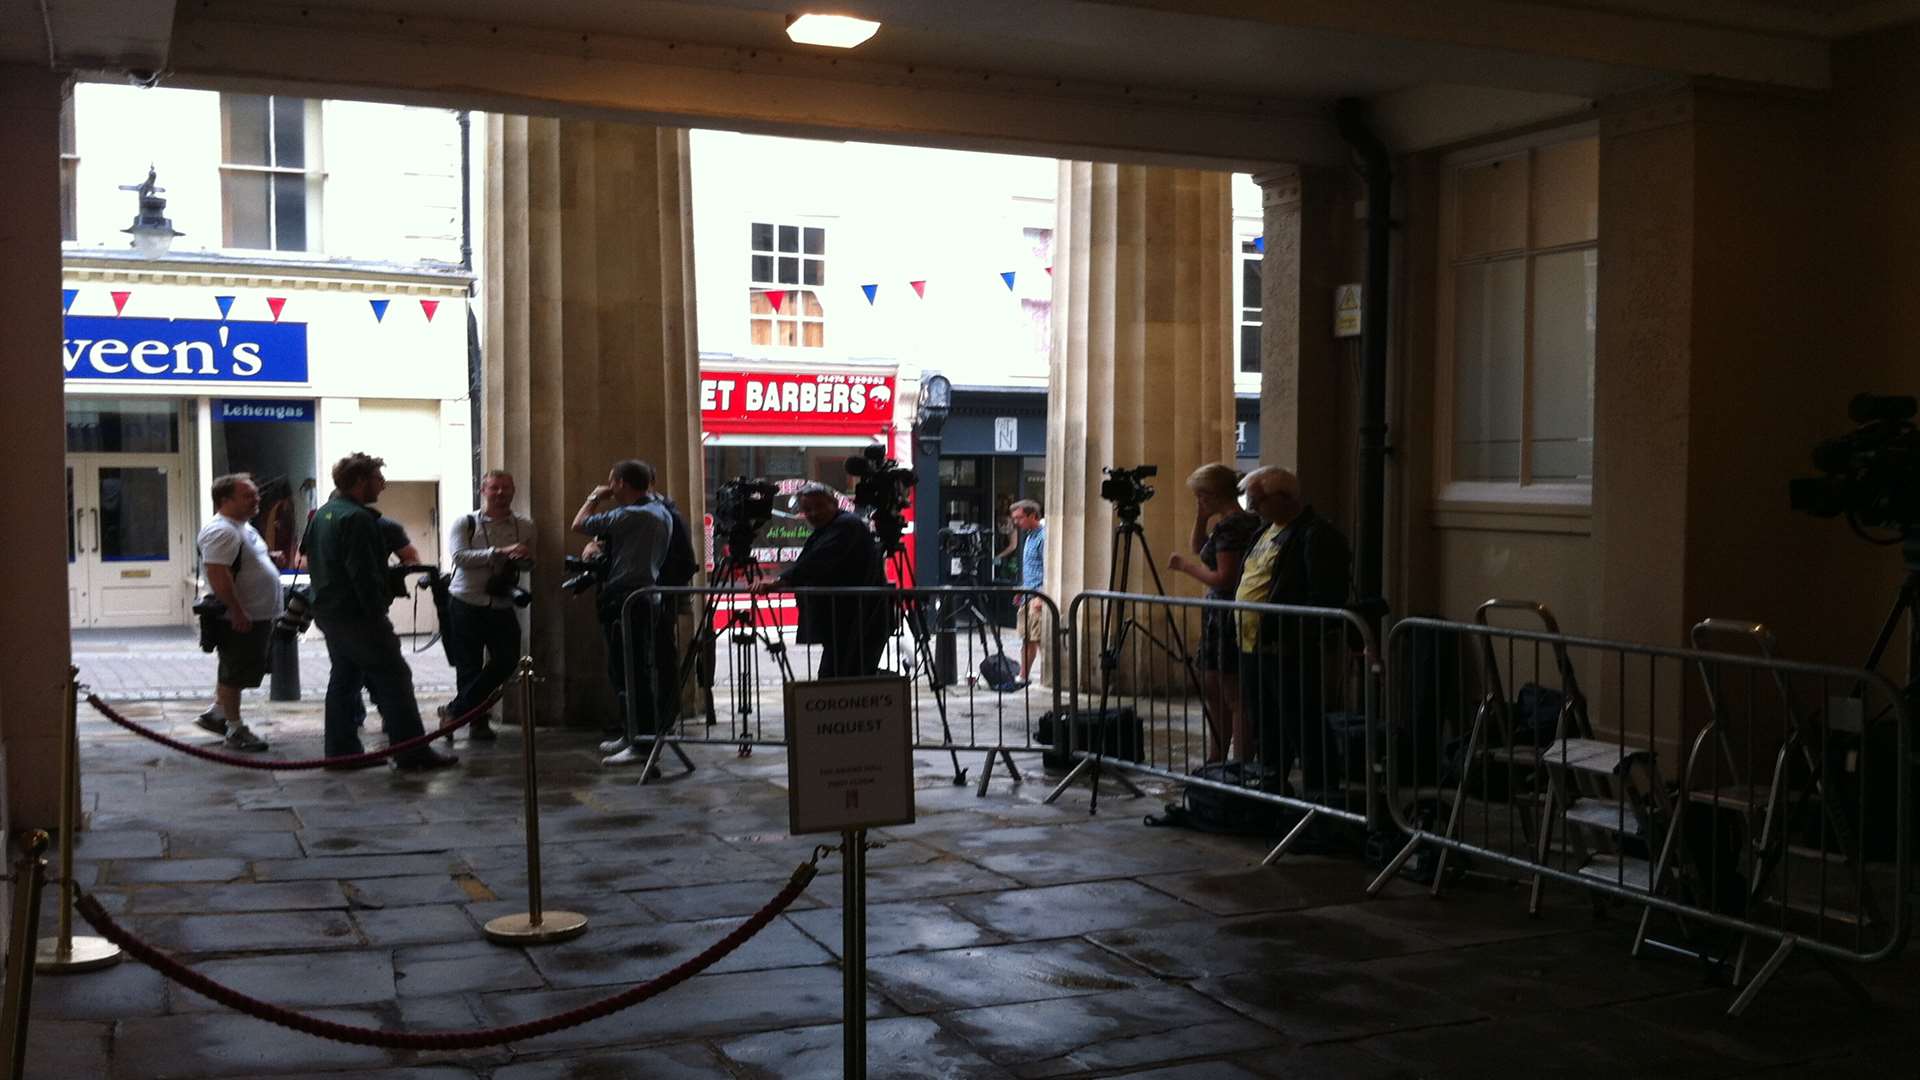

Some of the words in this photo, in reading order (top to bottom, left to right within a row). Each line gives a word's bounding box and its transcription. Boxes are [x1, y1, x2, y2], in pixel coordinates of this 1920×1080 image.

[700, 380, 735, 411] ET
[746, 381, 866, 413] BARBERS
[223, 404, 303, 419] Lehengas
[805, 694, 893, 713] CORONER'S
[816, 719, 883, 736] INQUEST
